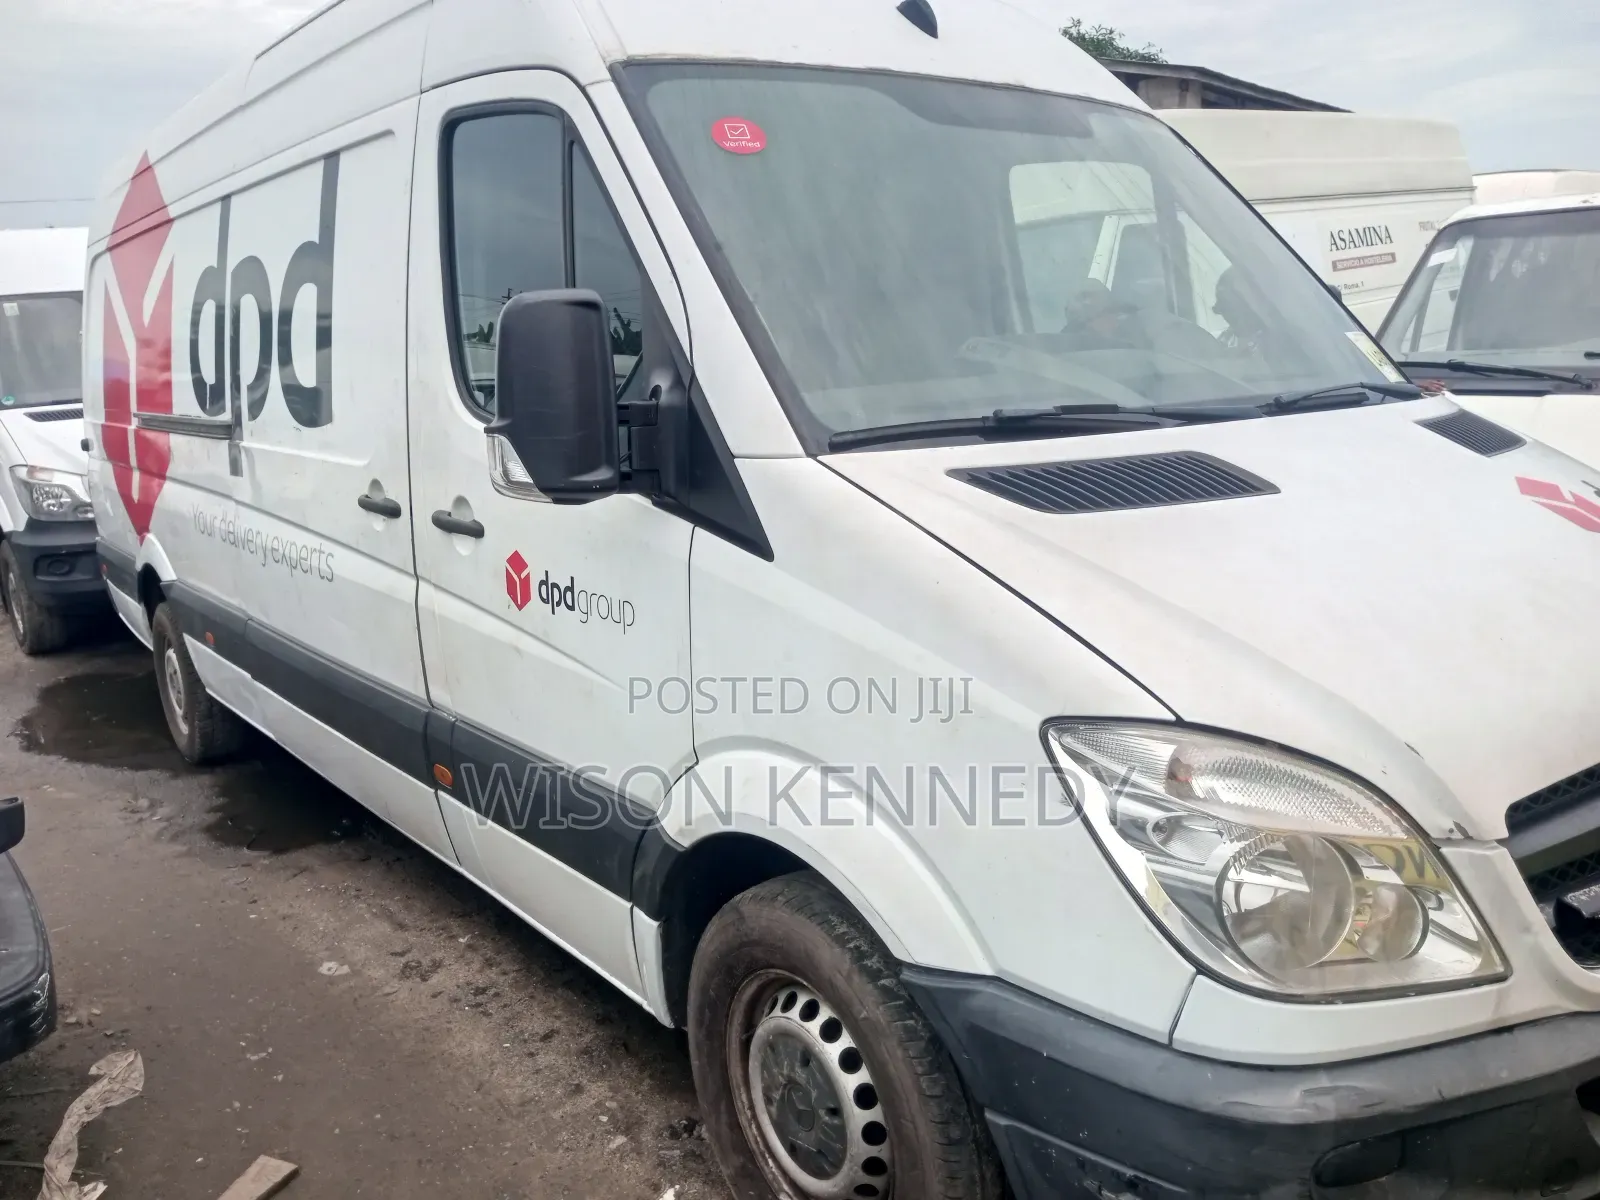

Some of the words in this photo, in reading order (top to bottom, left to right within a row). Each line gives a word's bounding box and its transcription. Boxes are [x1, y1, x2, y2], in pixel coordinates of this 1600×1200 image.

[722, 140, 761, 149] Verified
[1329, 224, 1394, 252] ASAMINA
[1336, 258, 1360, 269] SERVICIO
[189, 151, 341, 477] dpd
[191, 502, 217, 539] Your
[218, 510, 269, 568] delivery
[271, 535, 335, 583] experts
[538, 569, 636, 635] dpdgroup
